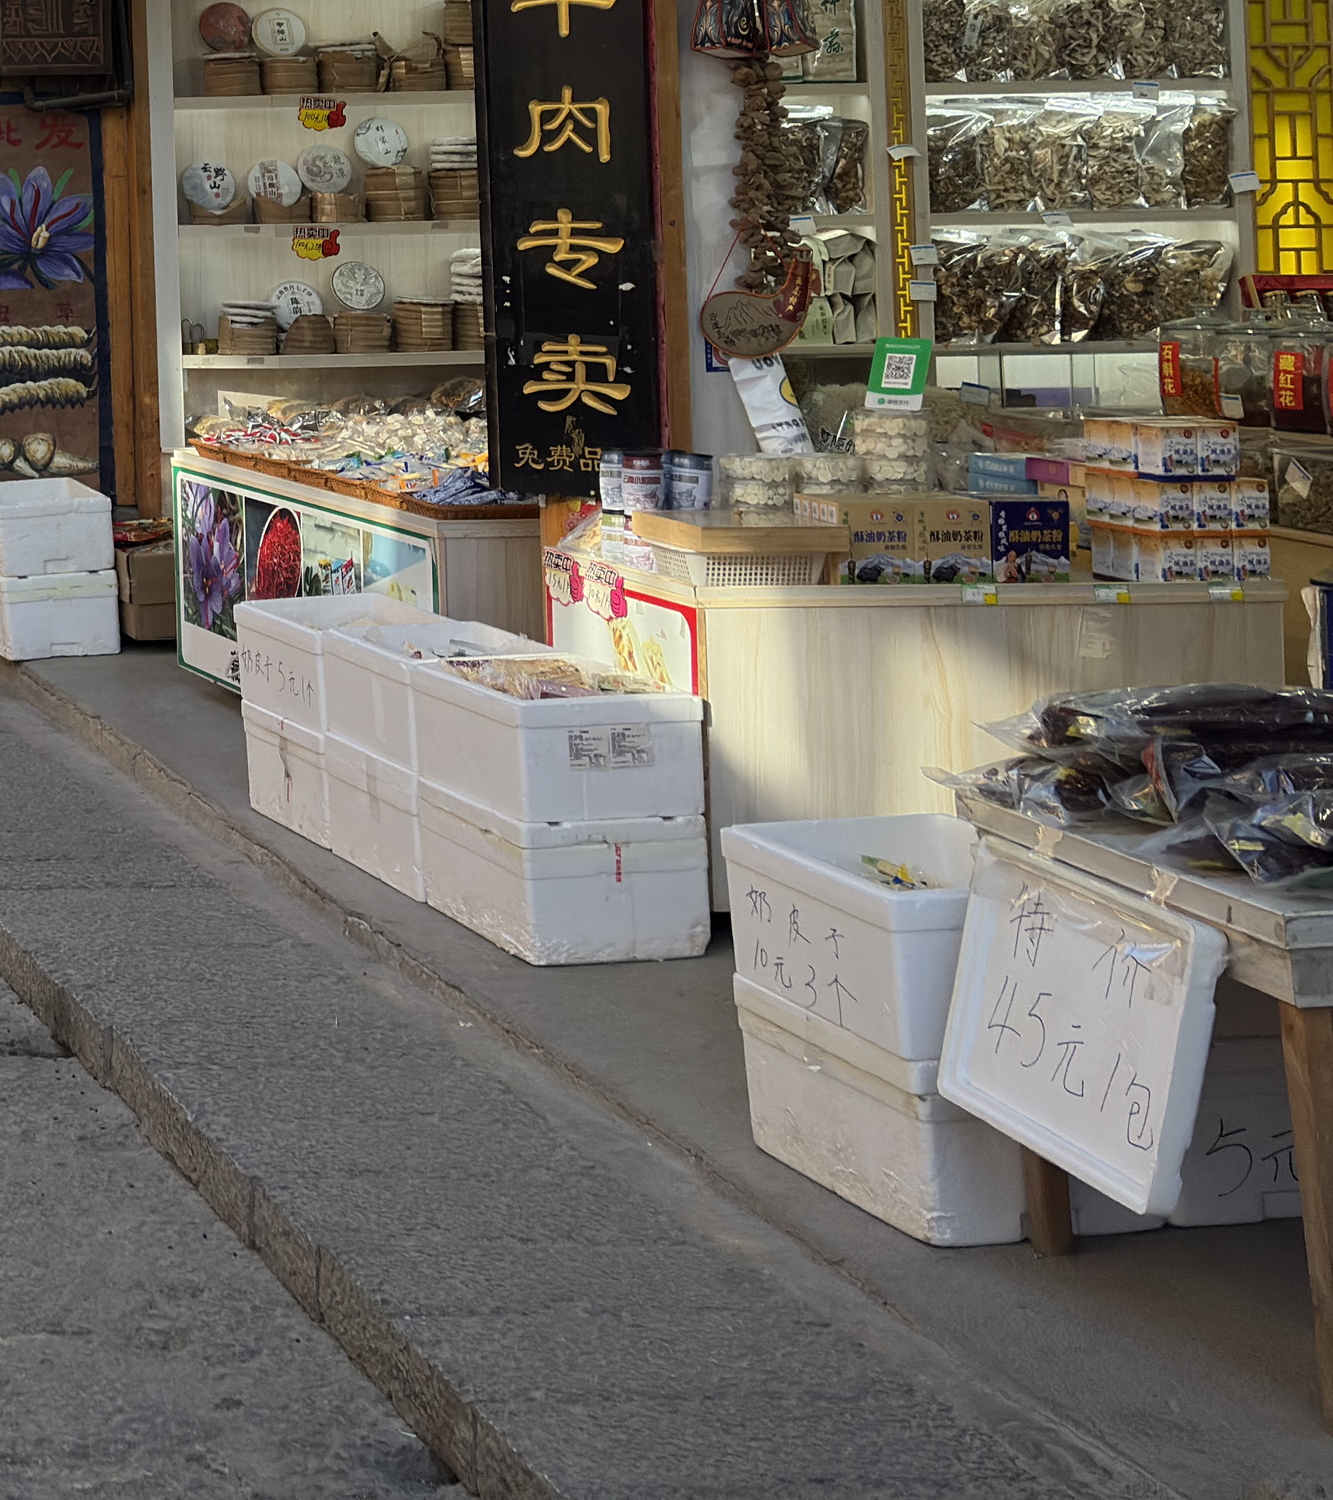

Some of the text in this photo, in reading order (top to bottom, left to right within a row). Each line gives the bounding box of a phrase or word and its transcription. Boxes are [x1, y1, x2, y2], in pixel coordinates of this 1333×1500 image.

[853, 530, 908, 544] 酥油奶茶粉
[929, 529, 984, 543] 酥油奶茶粉
[544, 550, 573, 573] 热卖中
[585, 562, 617, 586] 热卖中
[1010, 882, 1152, 1009] 特价
[988, 974, 1154, 1153] 45元1包
